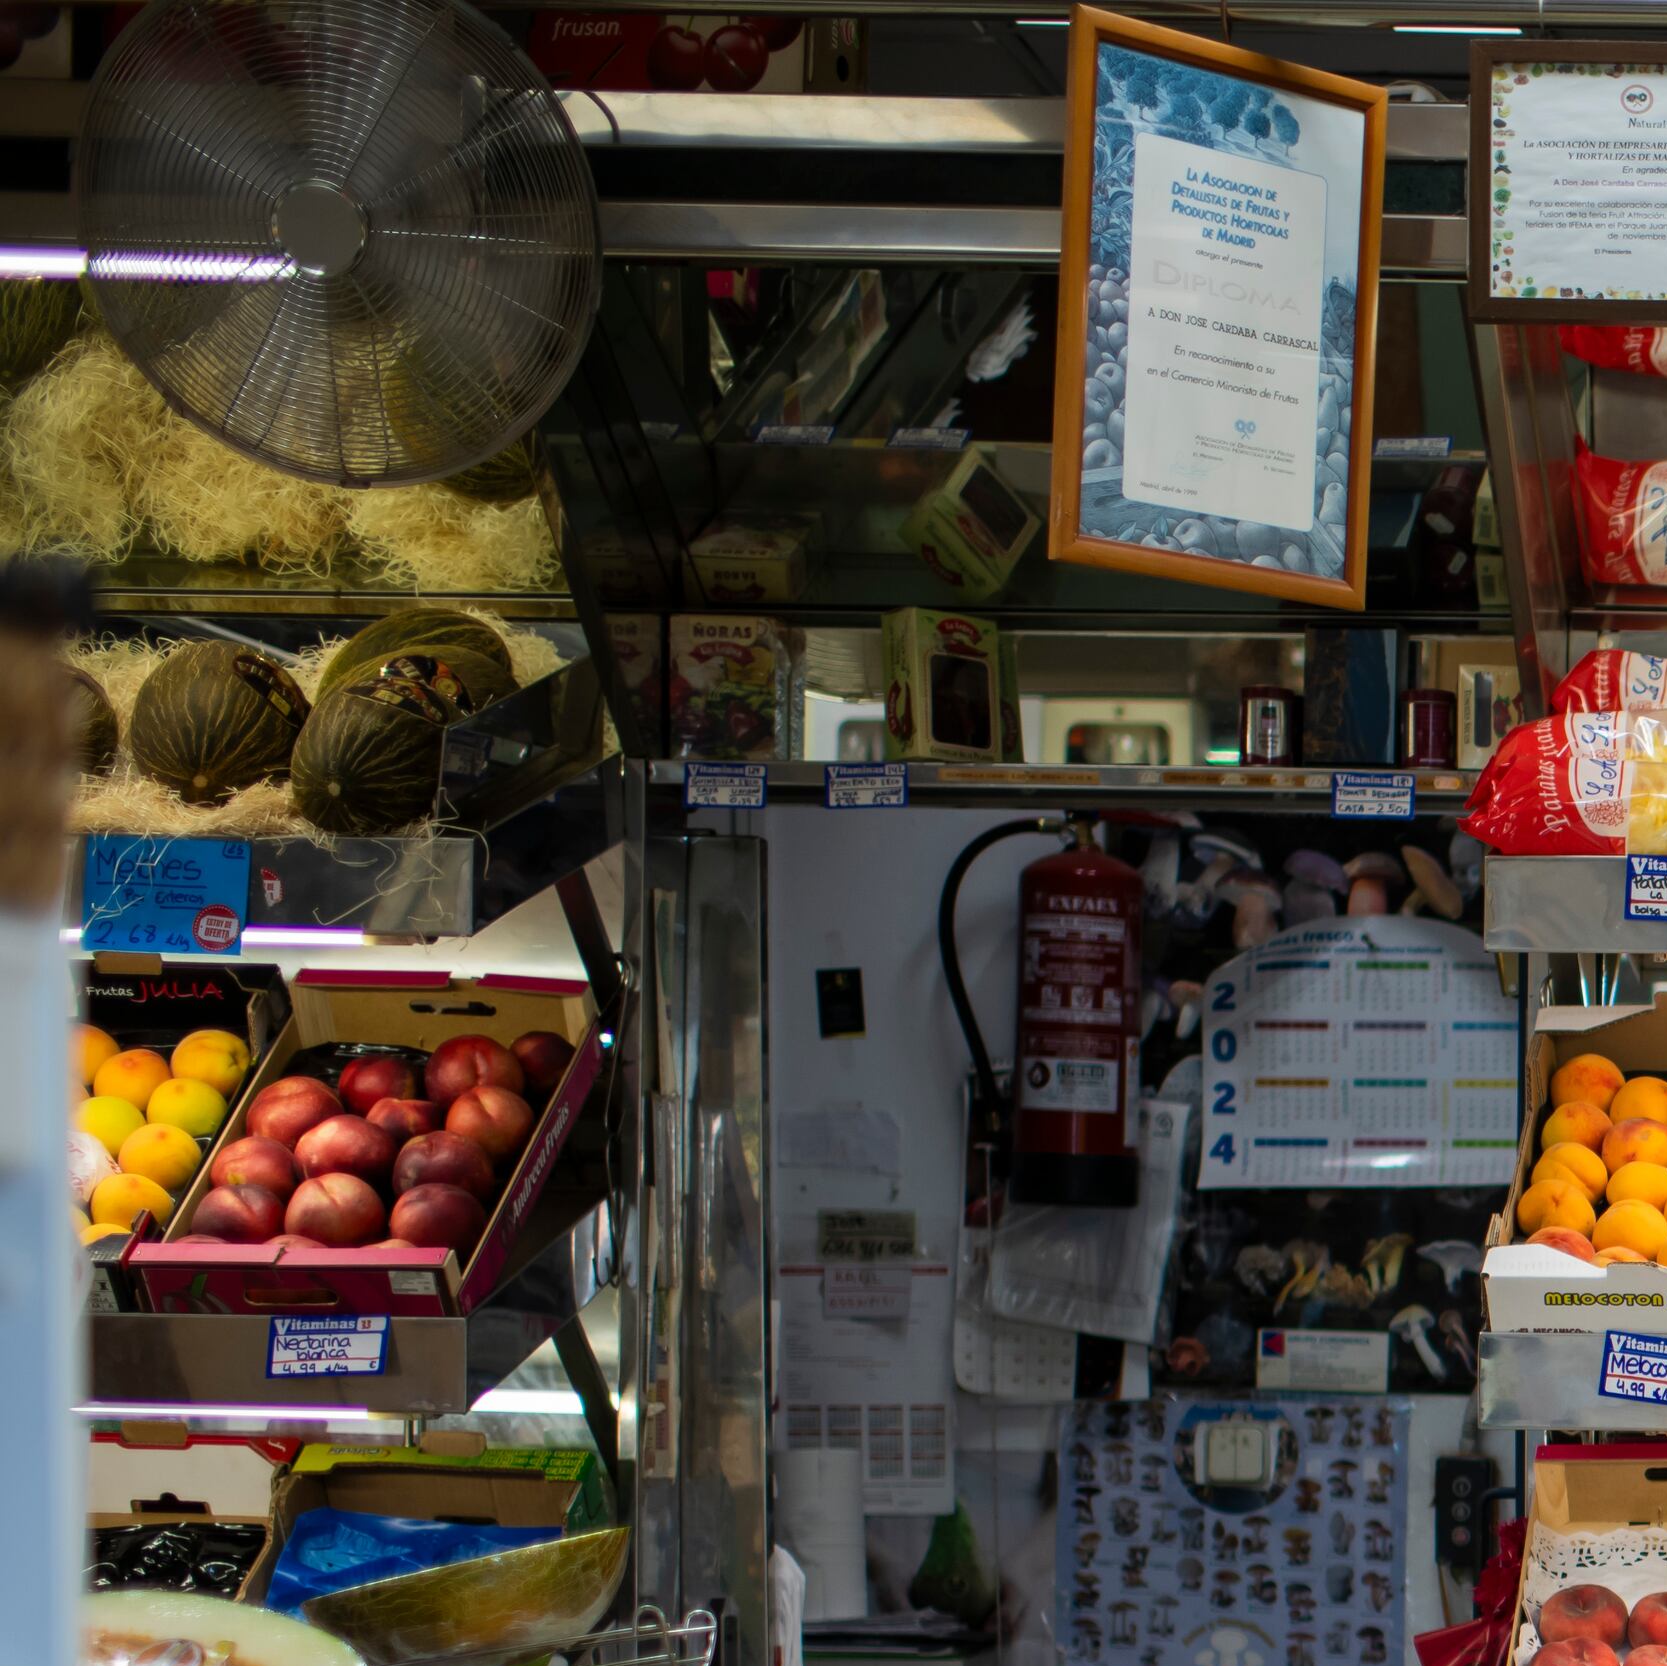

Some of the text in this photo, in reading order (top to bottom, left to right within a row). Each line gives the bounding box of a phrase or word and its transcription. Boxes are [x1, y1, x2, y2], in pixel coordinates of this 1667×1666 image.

[551, 17, 622, 42] frusan
[1523, 140, 1534, 149] La
[1536, 139, 1596, 149] ASOCIACIÓN
[1598, 141, 1611, 149] DE
[1576, 152, 1636, 161] HORTALIZAS
[1638, 153, 1650, 161] DE
[1622, 166, 1634, 174] En
[1201, 171, 1262, 199] ASOCIACION
[1171, 181, 1228, 208] DETALLISTAS
[1245, 200, 1281, 221] FRUTAS
[1171, 199, 1228, 226] PRODUCTOS
[1216, 228, 1256, 249] MADRID
[1152, 259, 1301, 316] DIPLOMA
[1147, 307, 1319, 352] A DON JOSE CARDABA CARRASCAL
[1174, 345, 1186, 357] En
[1188, 350, 1254, 372] reconocimiento
[1265, 367, 1276, 376] su
[1147, 367, 1299, 405] en el Comercio Minorista de Frutas
[1335, 775, 1392, 788] Vitaminas
[1650, 890, 1663, 900] La
[1634, 905, 1660, 915] Bolsa
[86, 980, 224, 1004] Frutas JULIA
[1545, 1292, 1663, 1306] MELOCOTON
[275, 1317, 356, 1335] Vitaminas
[276, 1335, 351, 1351] Nectarina
[296, 1349, 349, 1360] blanca
